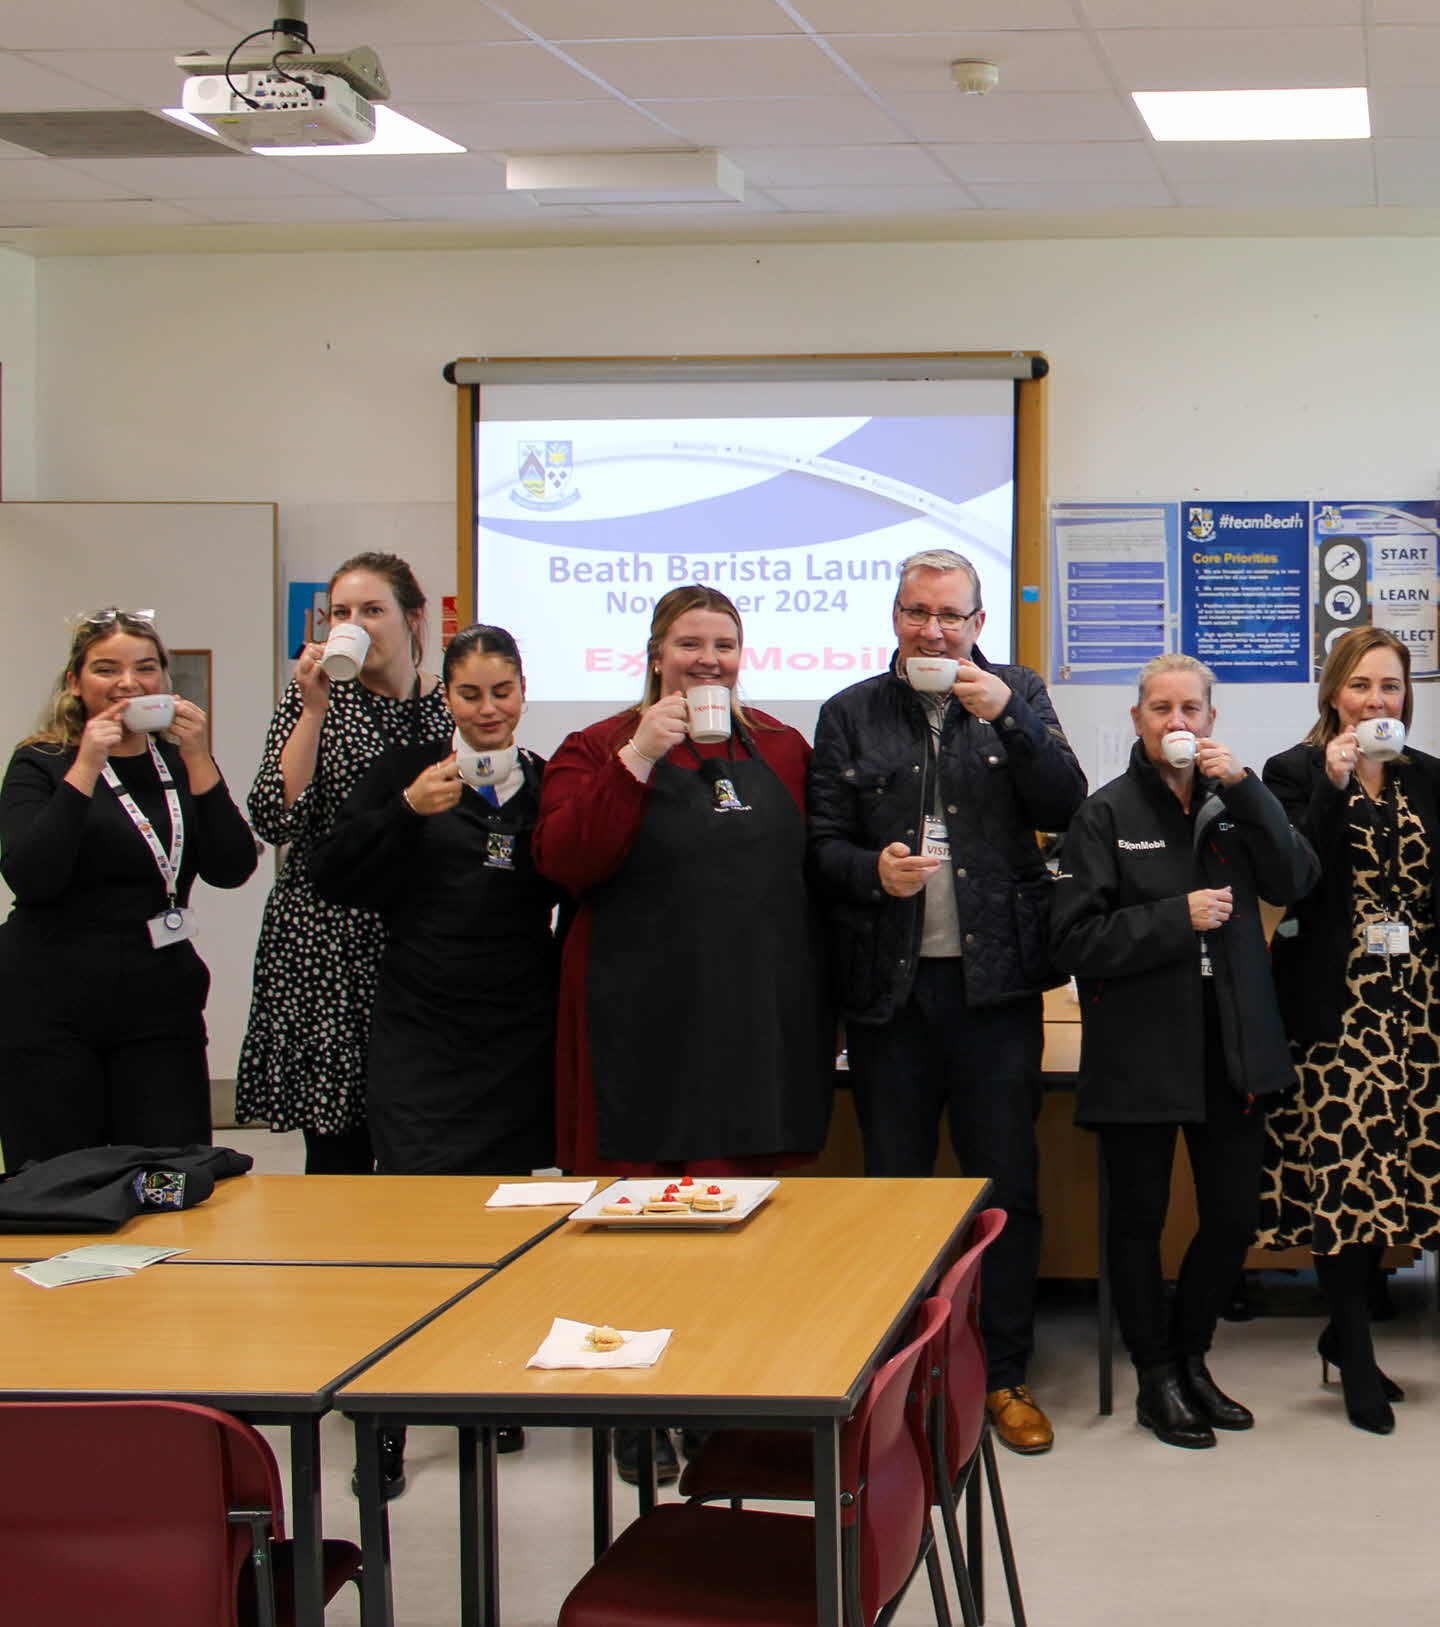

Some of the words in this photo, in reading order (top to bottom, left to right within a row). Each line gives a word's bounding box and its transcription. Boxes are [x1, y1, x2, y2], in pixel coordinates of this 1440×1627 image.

[1219, 512, 1303, 529] #teamBeath
[1192, 552, 1222, 564] Core
[1224, 552, 1279, 564] Priorities
[1381, 548, 1429, 560] START
[549, 552, 653, 583] Beath
[667, 553, 792, 582] Barista
[806, 553, 904, 581] Laun
[775, 589, 848, 613] 2024
[1380, 589, 1429, 601] LEARN
[1392, 630, 1436, 641] FLECT
